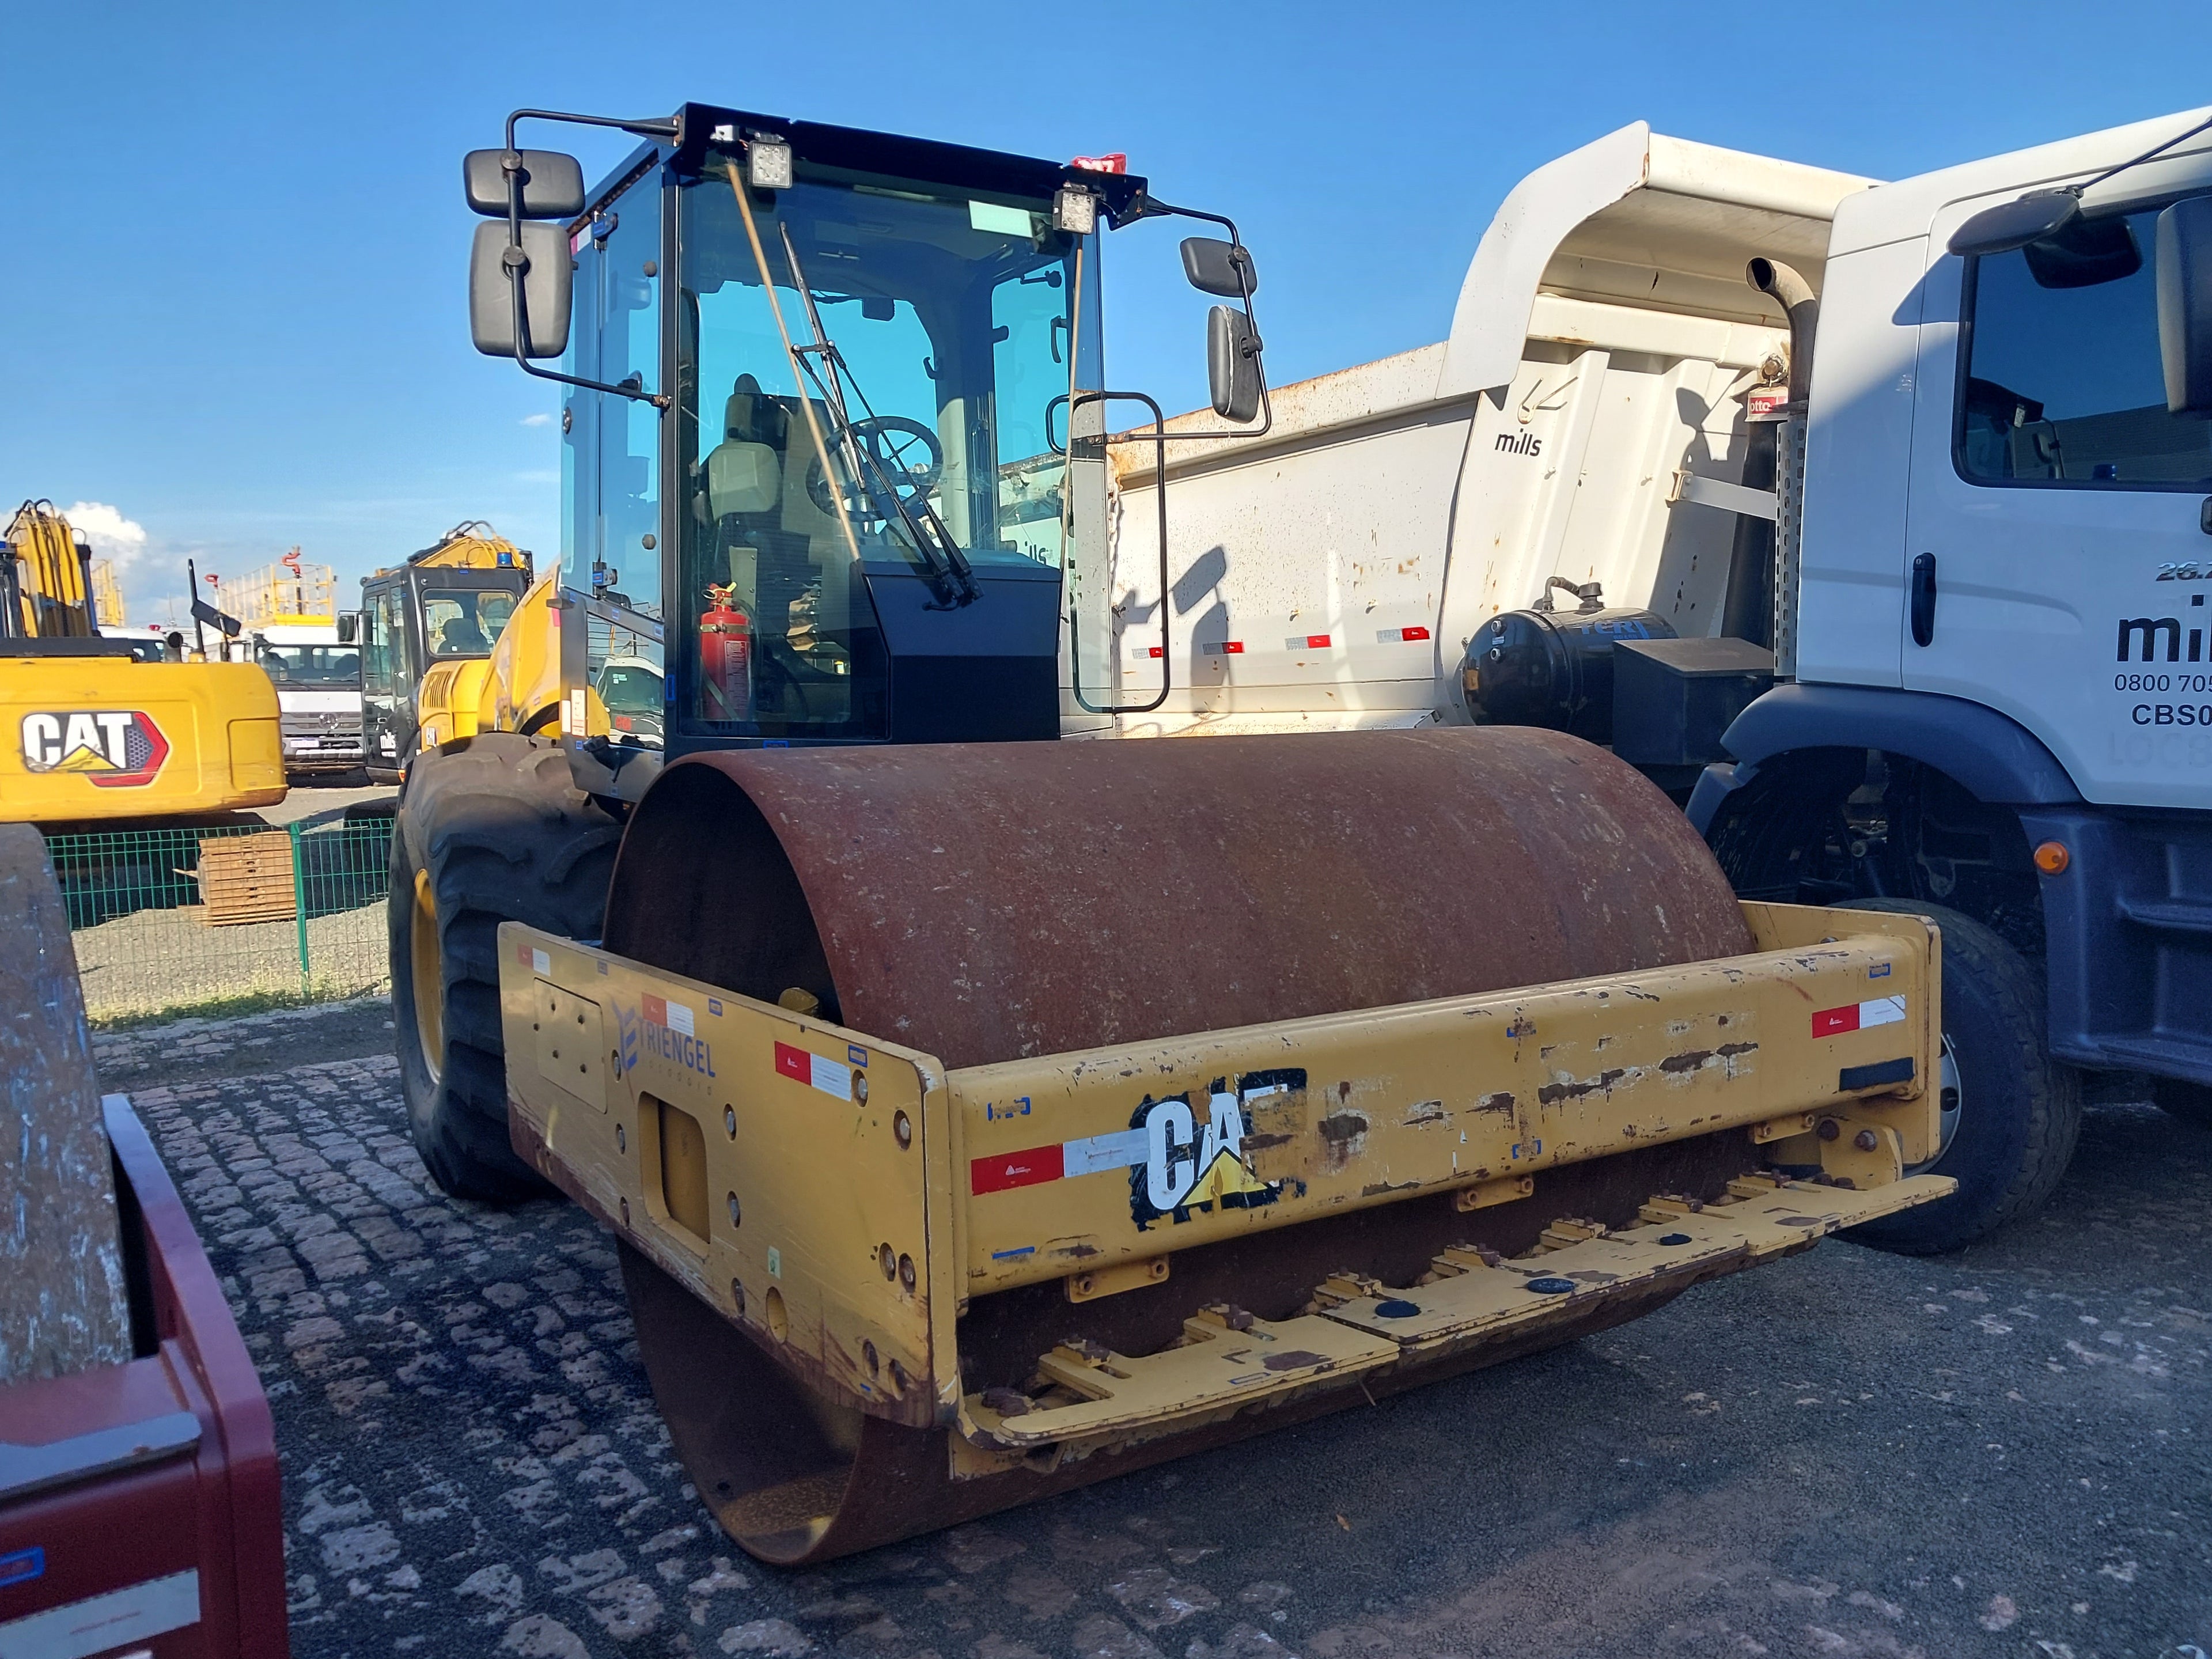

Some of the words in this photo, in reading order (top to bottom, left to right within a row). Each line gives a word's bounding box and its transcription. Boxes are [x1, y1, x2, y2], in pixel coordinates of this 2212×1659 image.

[1495, 428, 1542, 457] mills
[2117, 594, 2212, 662] mi
[2115, 674, 2170, 691] 0800
[22, 713, 132, 770] CAT
